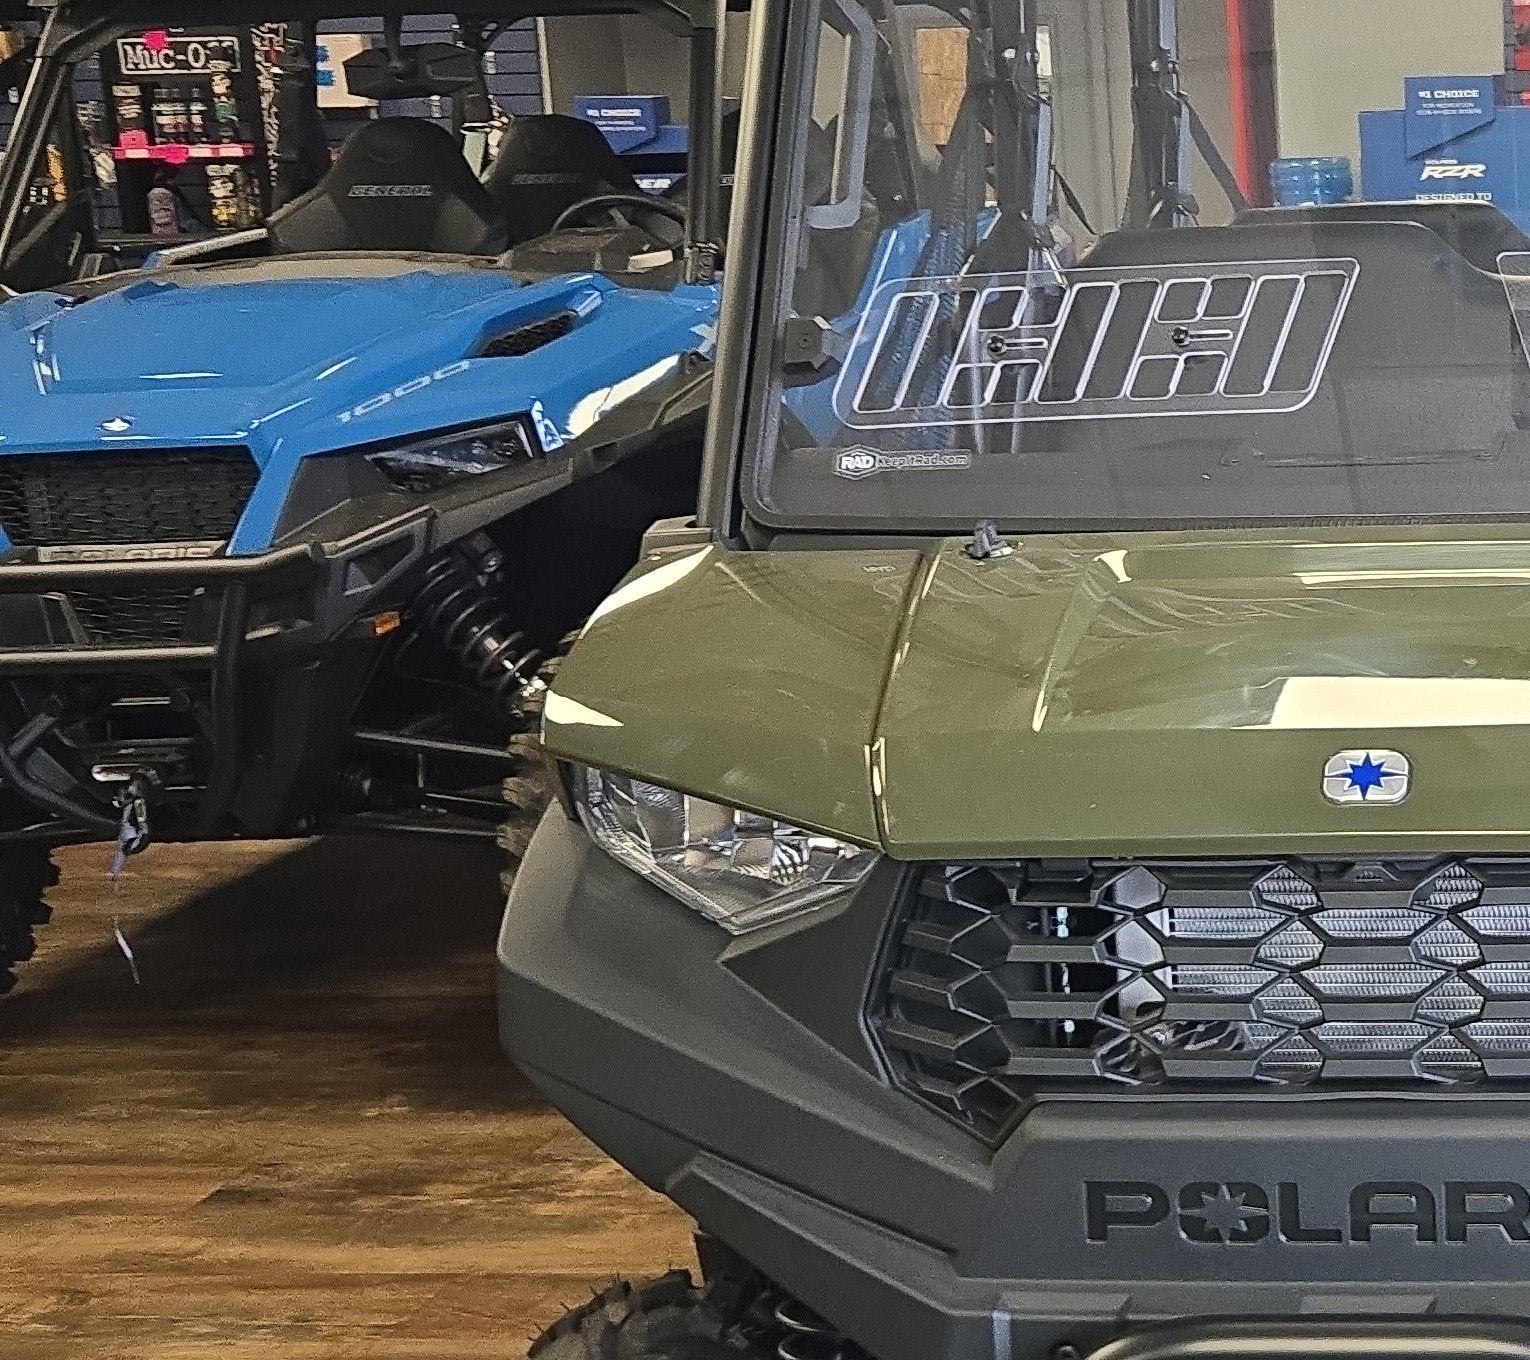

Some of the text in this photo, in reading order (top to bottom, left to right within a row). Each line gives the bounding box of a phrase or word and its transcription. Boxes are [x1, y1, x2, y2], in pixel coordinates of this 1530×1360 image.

[1433, 89, 1480, 99] CHOICE
[1420, 164, 1487, 181] RZR
[1476, 191, 1493, 201] TO
[337, 359, 471, 423] 1000
[841, 454, 876, 470] RAD
